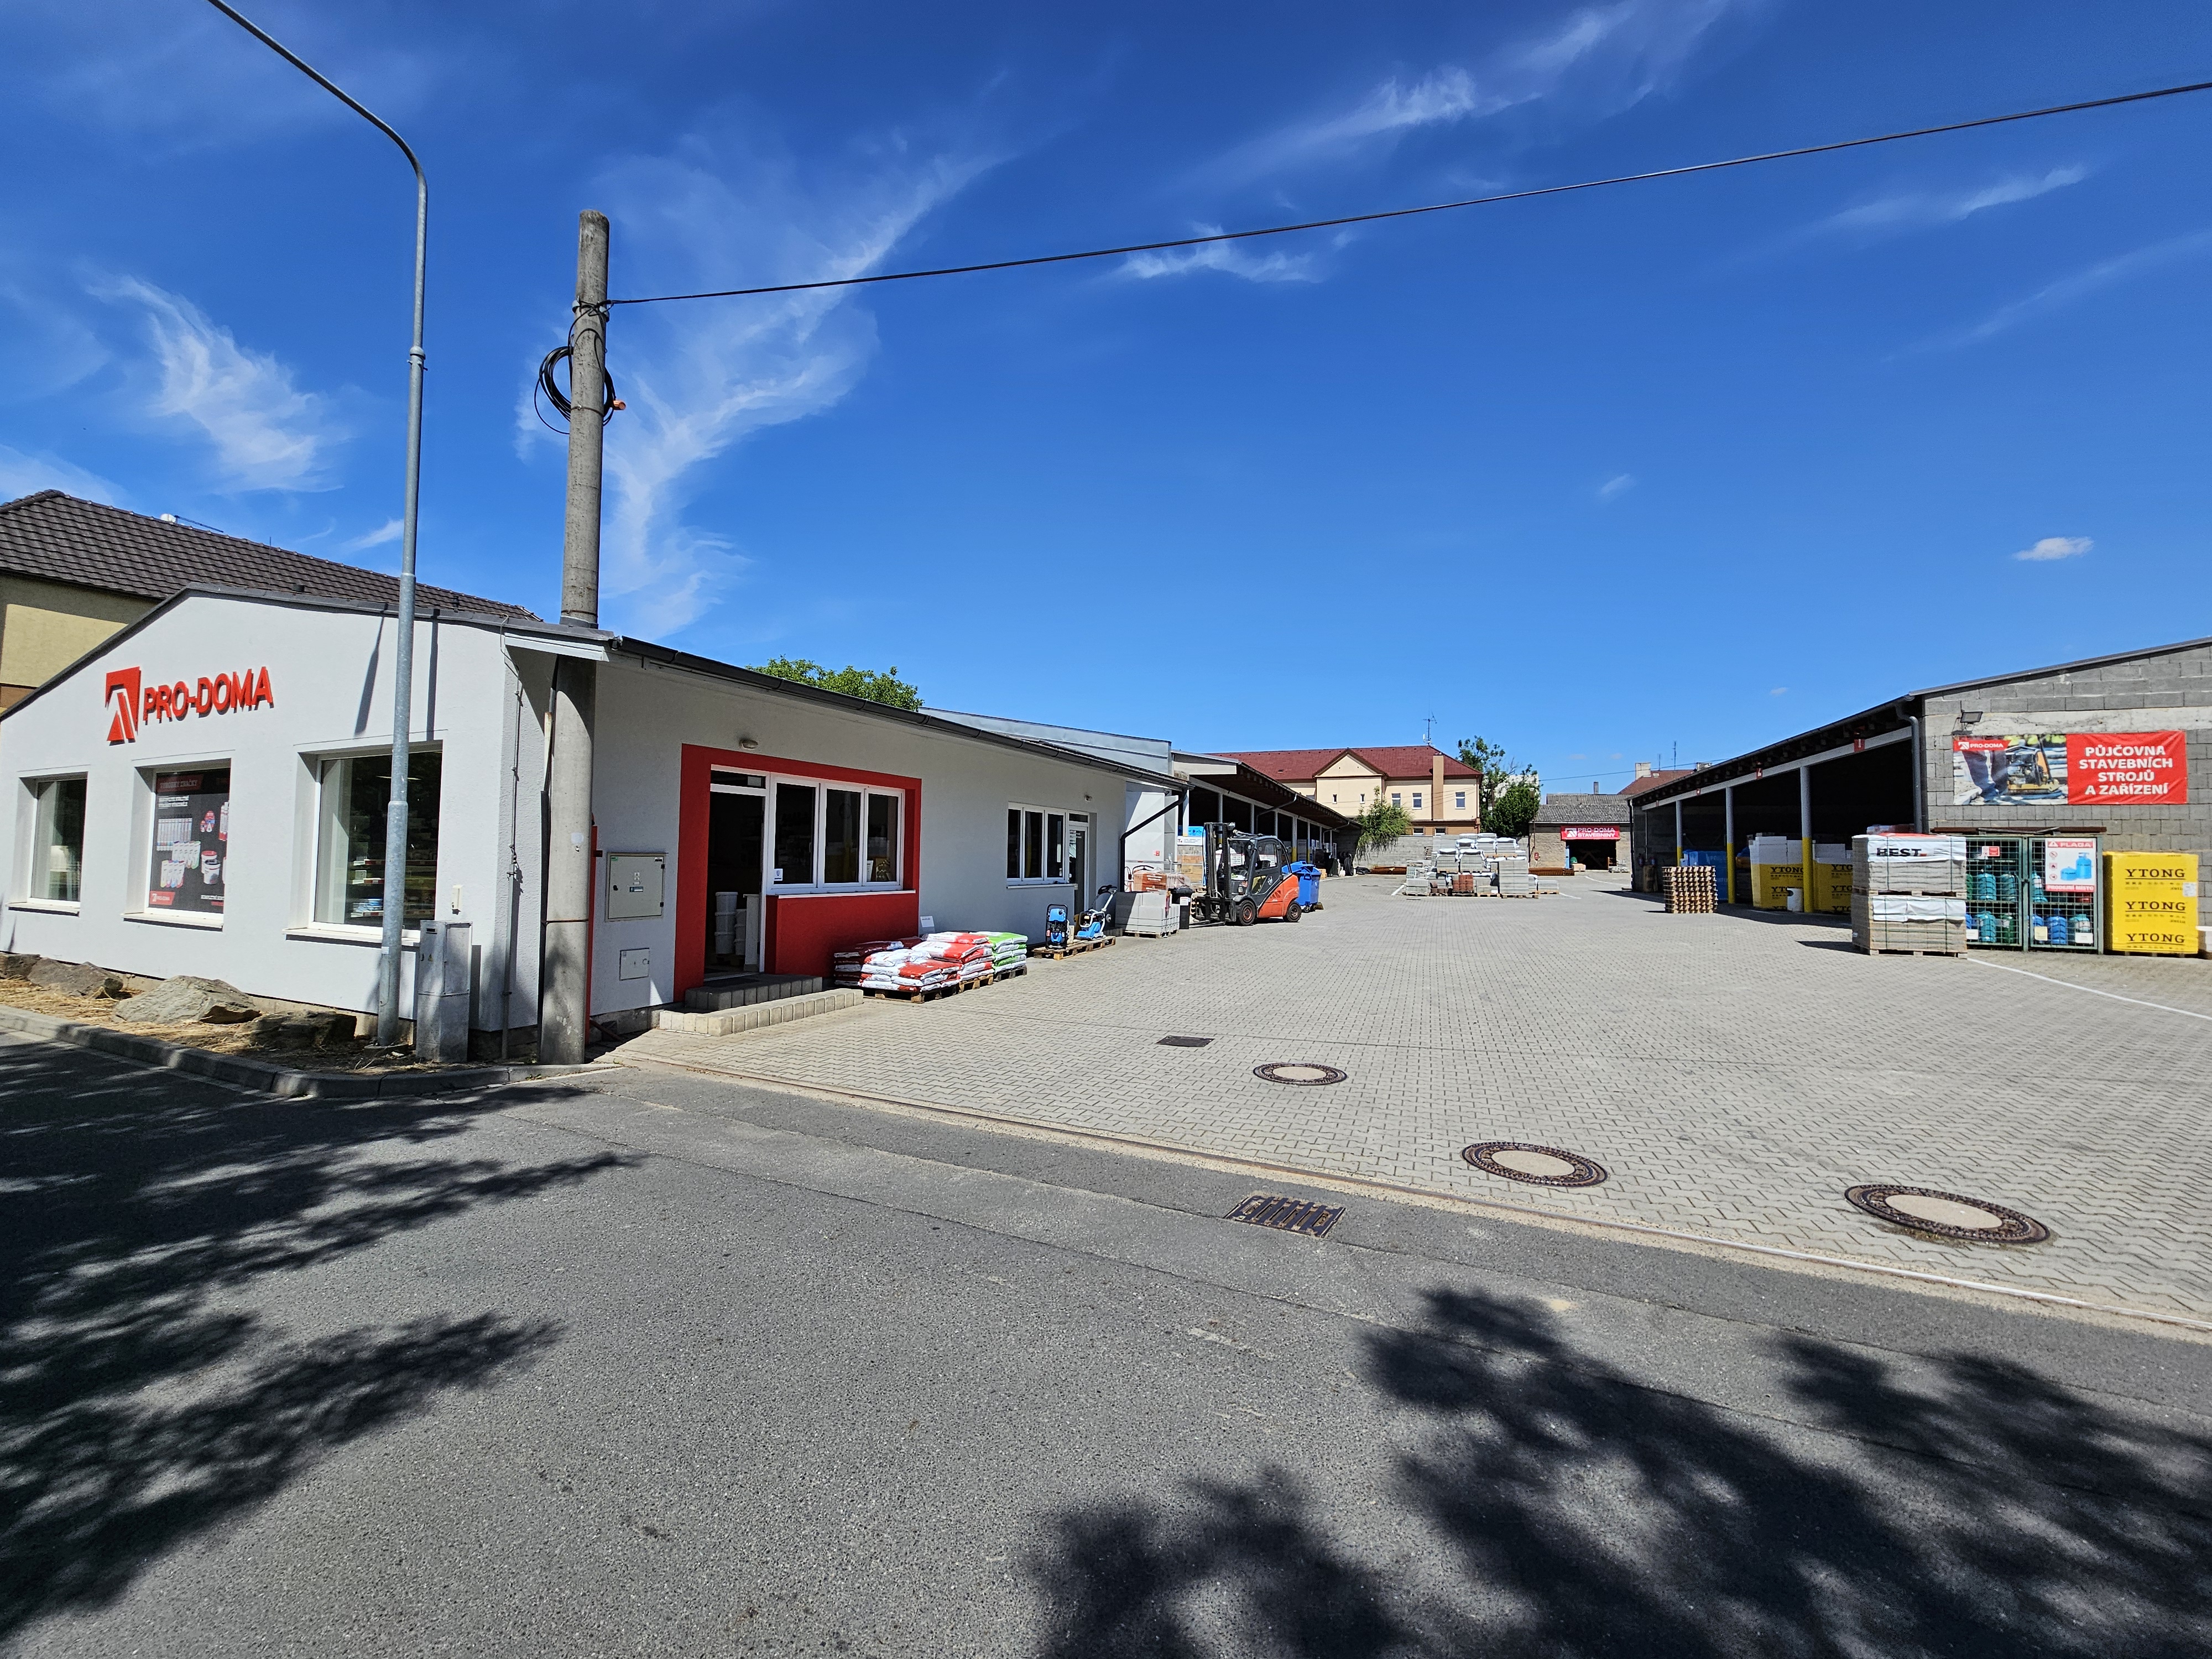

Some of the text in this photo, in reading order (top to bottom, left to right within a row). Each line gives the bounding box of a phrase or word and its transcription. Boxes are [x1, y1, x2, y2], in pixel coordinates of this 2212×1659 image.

[143, 666, 273, 721] PRO-DOMA
[2085, 744, 2166, 757] PŮJČOVNA
[2079, 757, 2173, 769] STAVEBNÍCH
[2098, 769, 2155, 782] STROJŮ
[2085, 782, 2168, 795] A ZAŘÍZENÍ
[2125, 869, 2185, 878] YTONG
[2125, 901, 2186, 911] YTONG
[2126, 933, 2185, 943] YTONG
